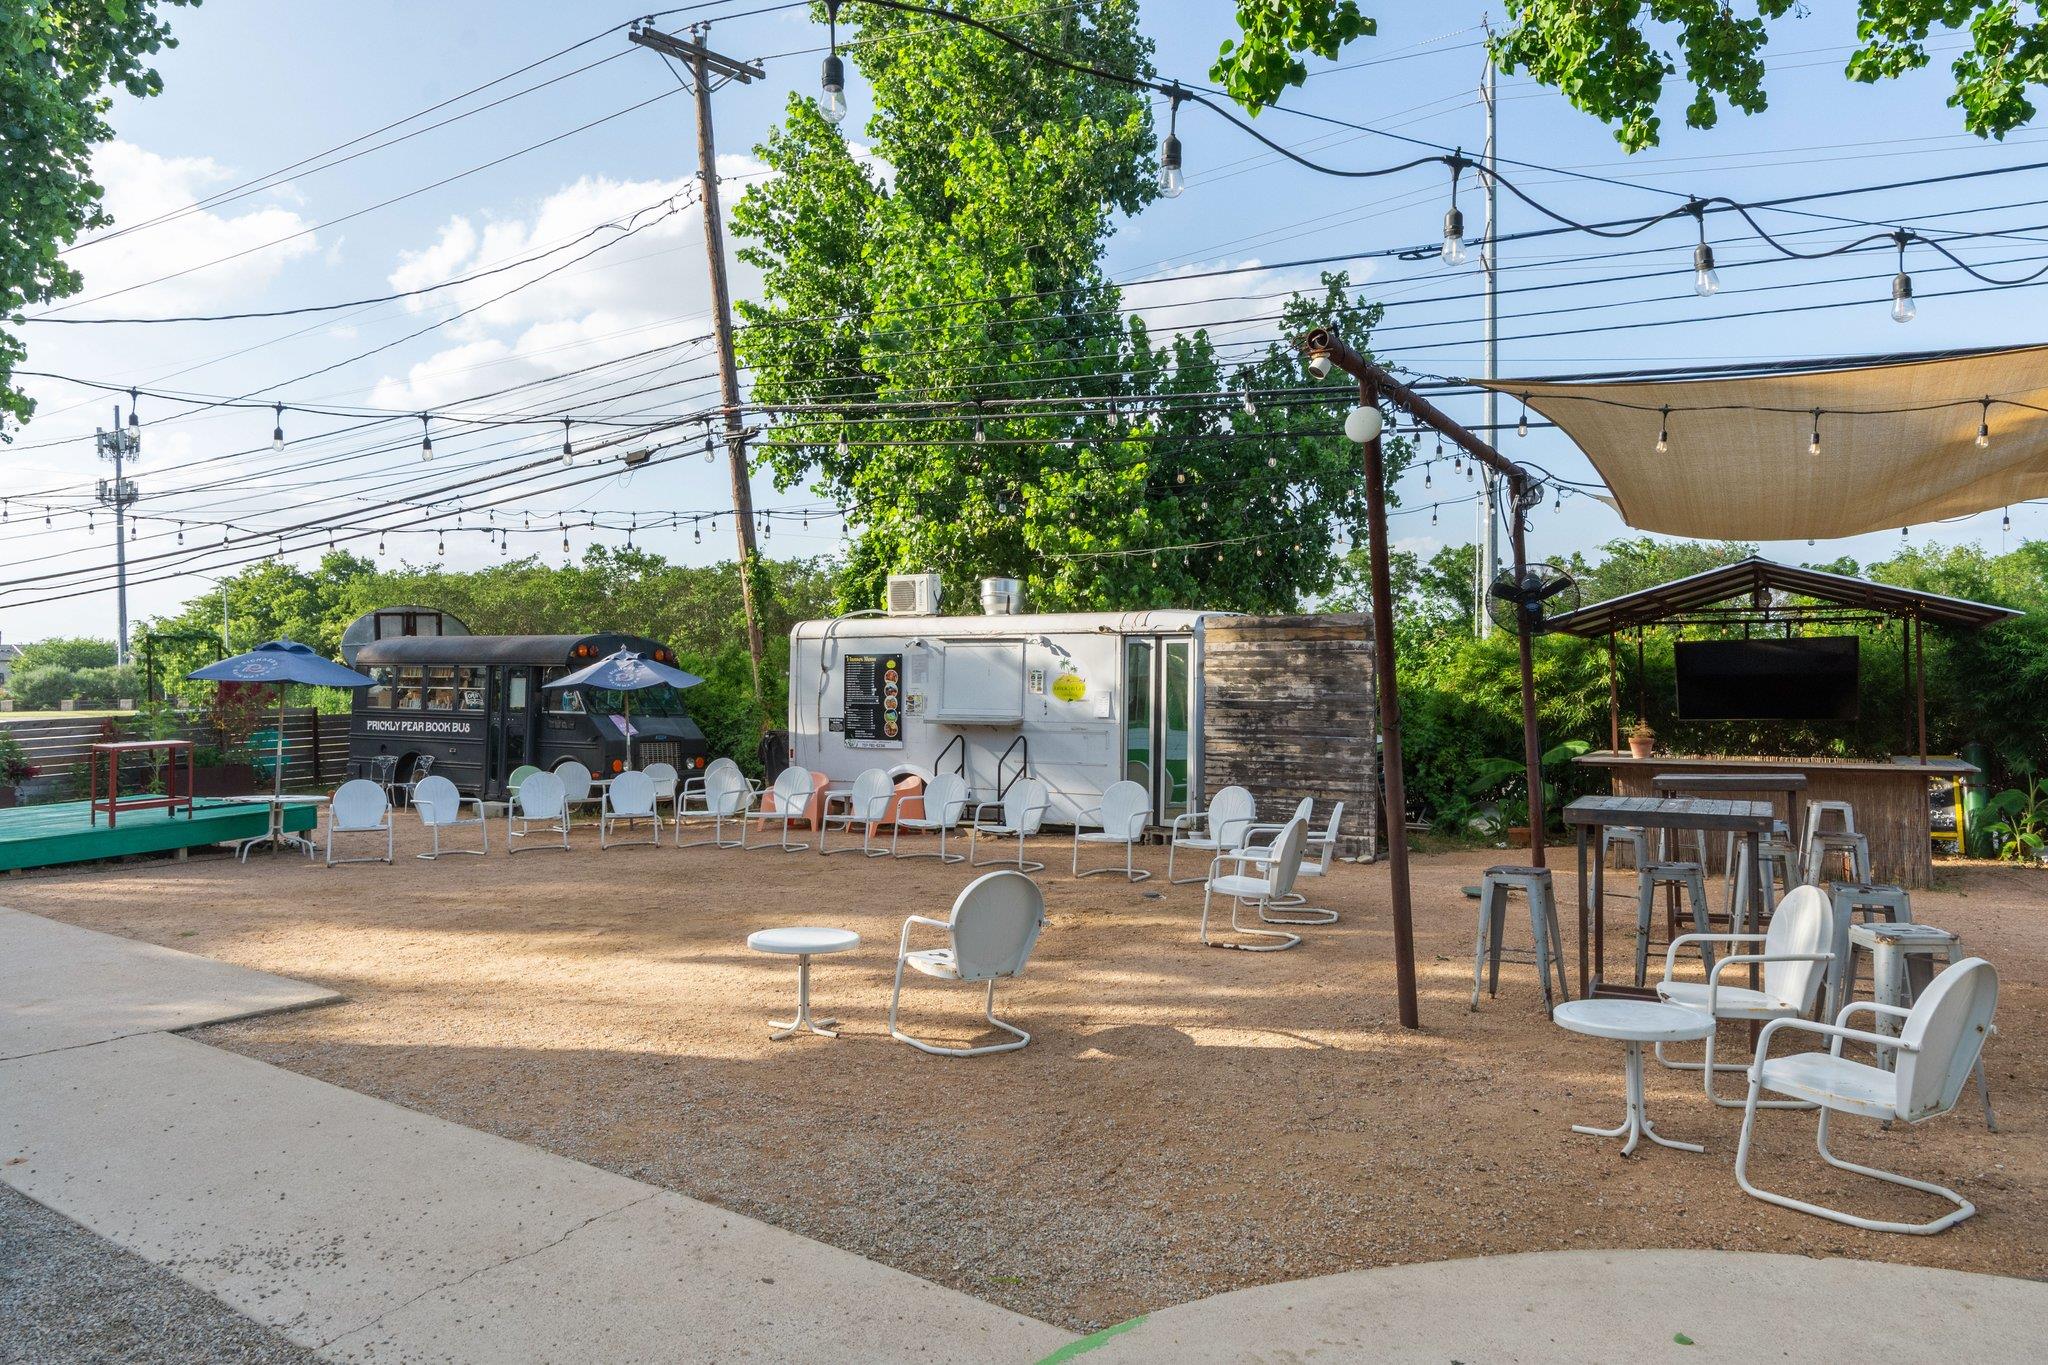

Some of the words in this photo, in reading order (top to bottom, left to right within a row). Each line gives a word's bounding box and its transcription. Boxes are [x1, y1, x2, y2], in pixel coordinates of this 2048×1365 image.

[367, 720, 400, 731] PRICKLY
[401, 721, 424, 732] PEAR
[425, 722, 451, 732] BOOK
[452, 722, 470, 733] BUS
